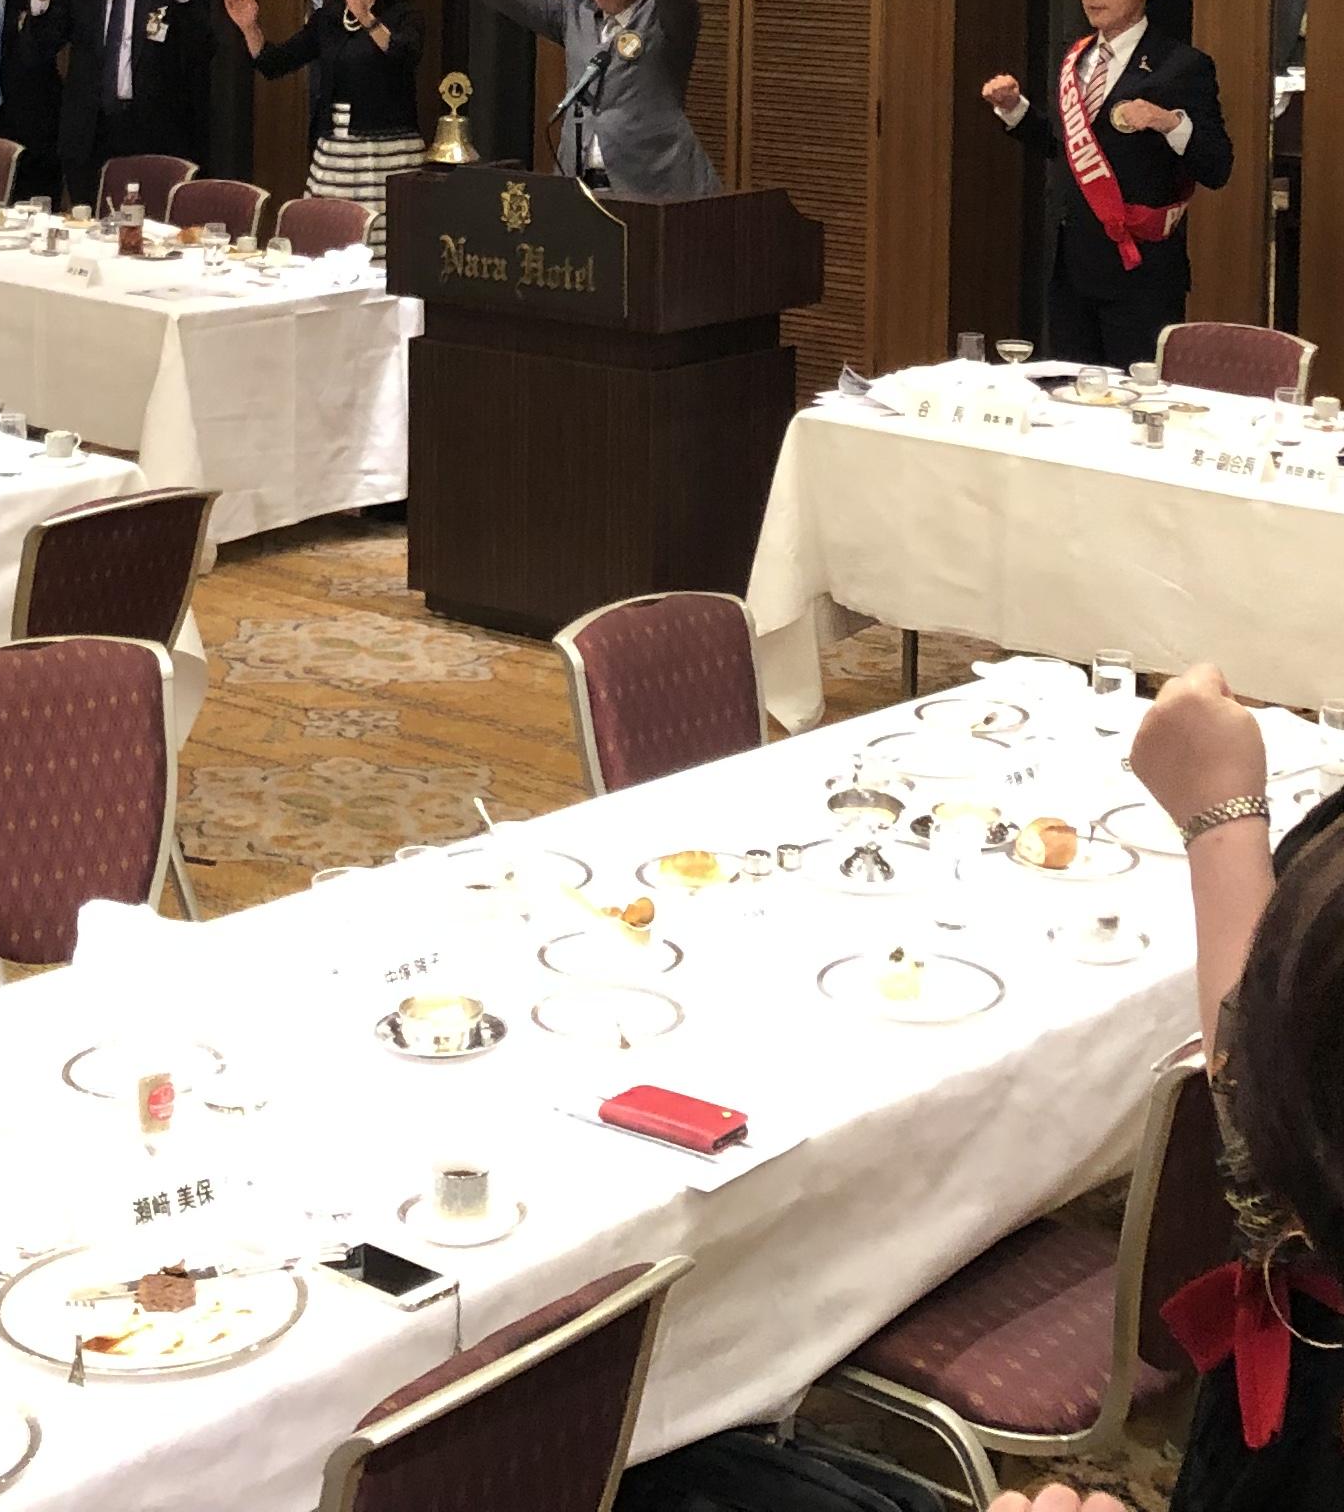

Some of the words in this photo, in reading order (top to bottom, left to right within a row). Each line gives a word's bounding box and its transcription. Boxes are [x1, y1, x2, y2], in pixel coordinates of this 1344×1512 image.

[1059, 50, 1111, 185] RESIDENT
[439, 234, 508, 283] Nara
[516, 243, 596, 299] Hotel
[176, 1178, 215, 1214] 美保
